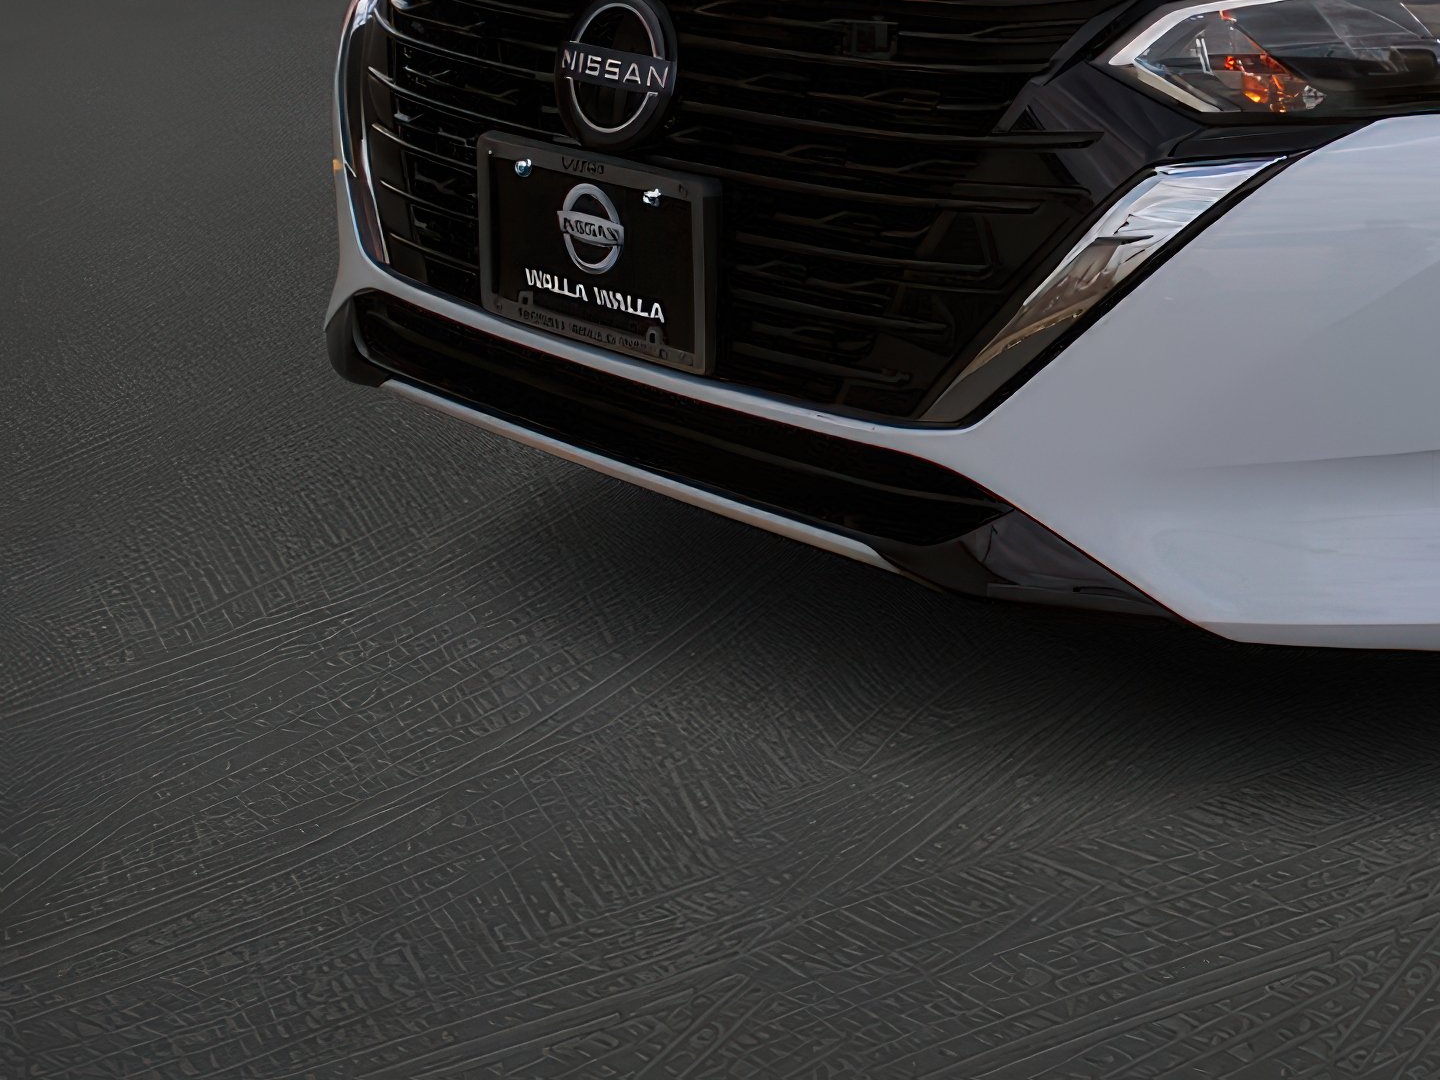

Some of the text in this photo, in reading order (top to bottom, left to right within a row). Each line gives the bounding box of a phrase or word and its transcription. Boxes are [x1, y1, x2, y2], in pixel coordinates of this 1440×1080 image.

[562, 49, 669, 89] NISSAN
[525, 268, 665, 323] WALLA WALLA
